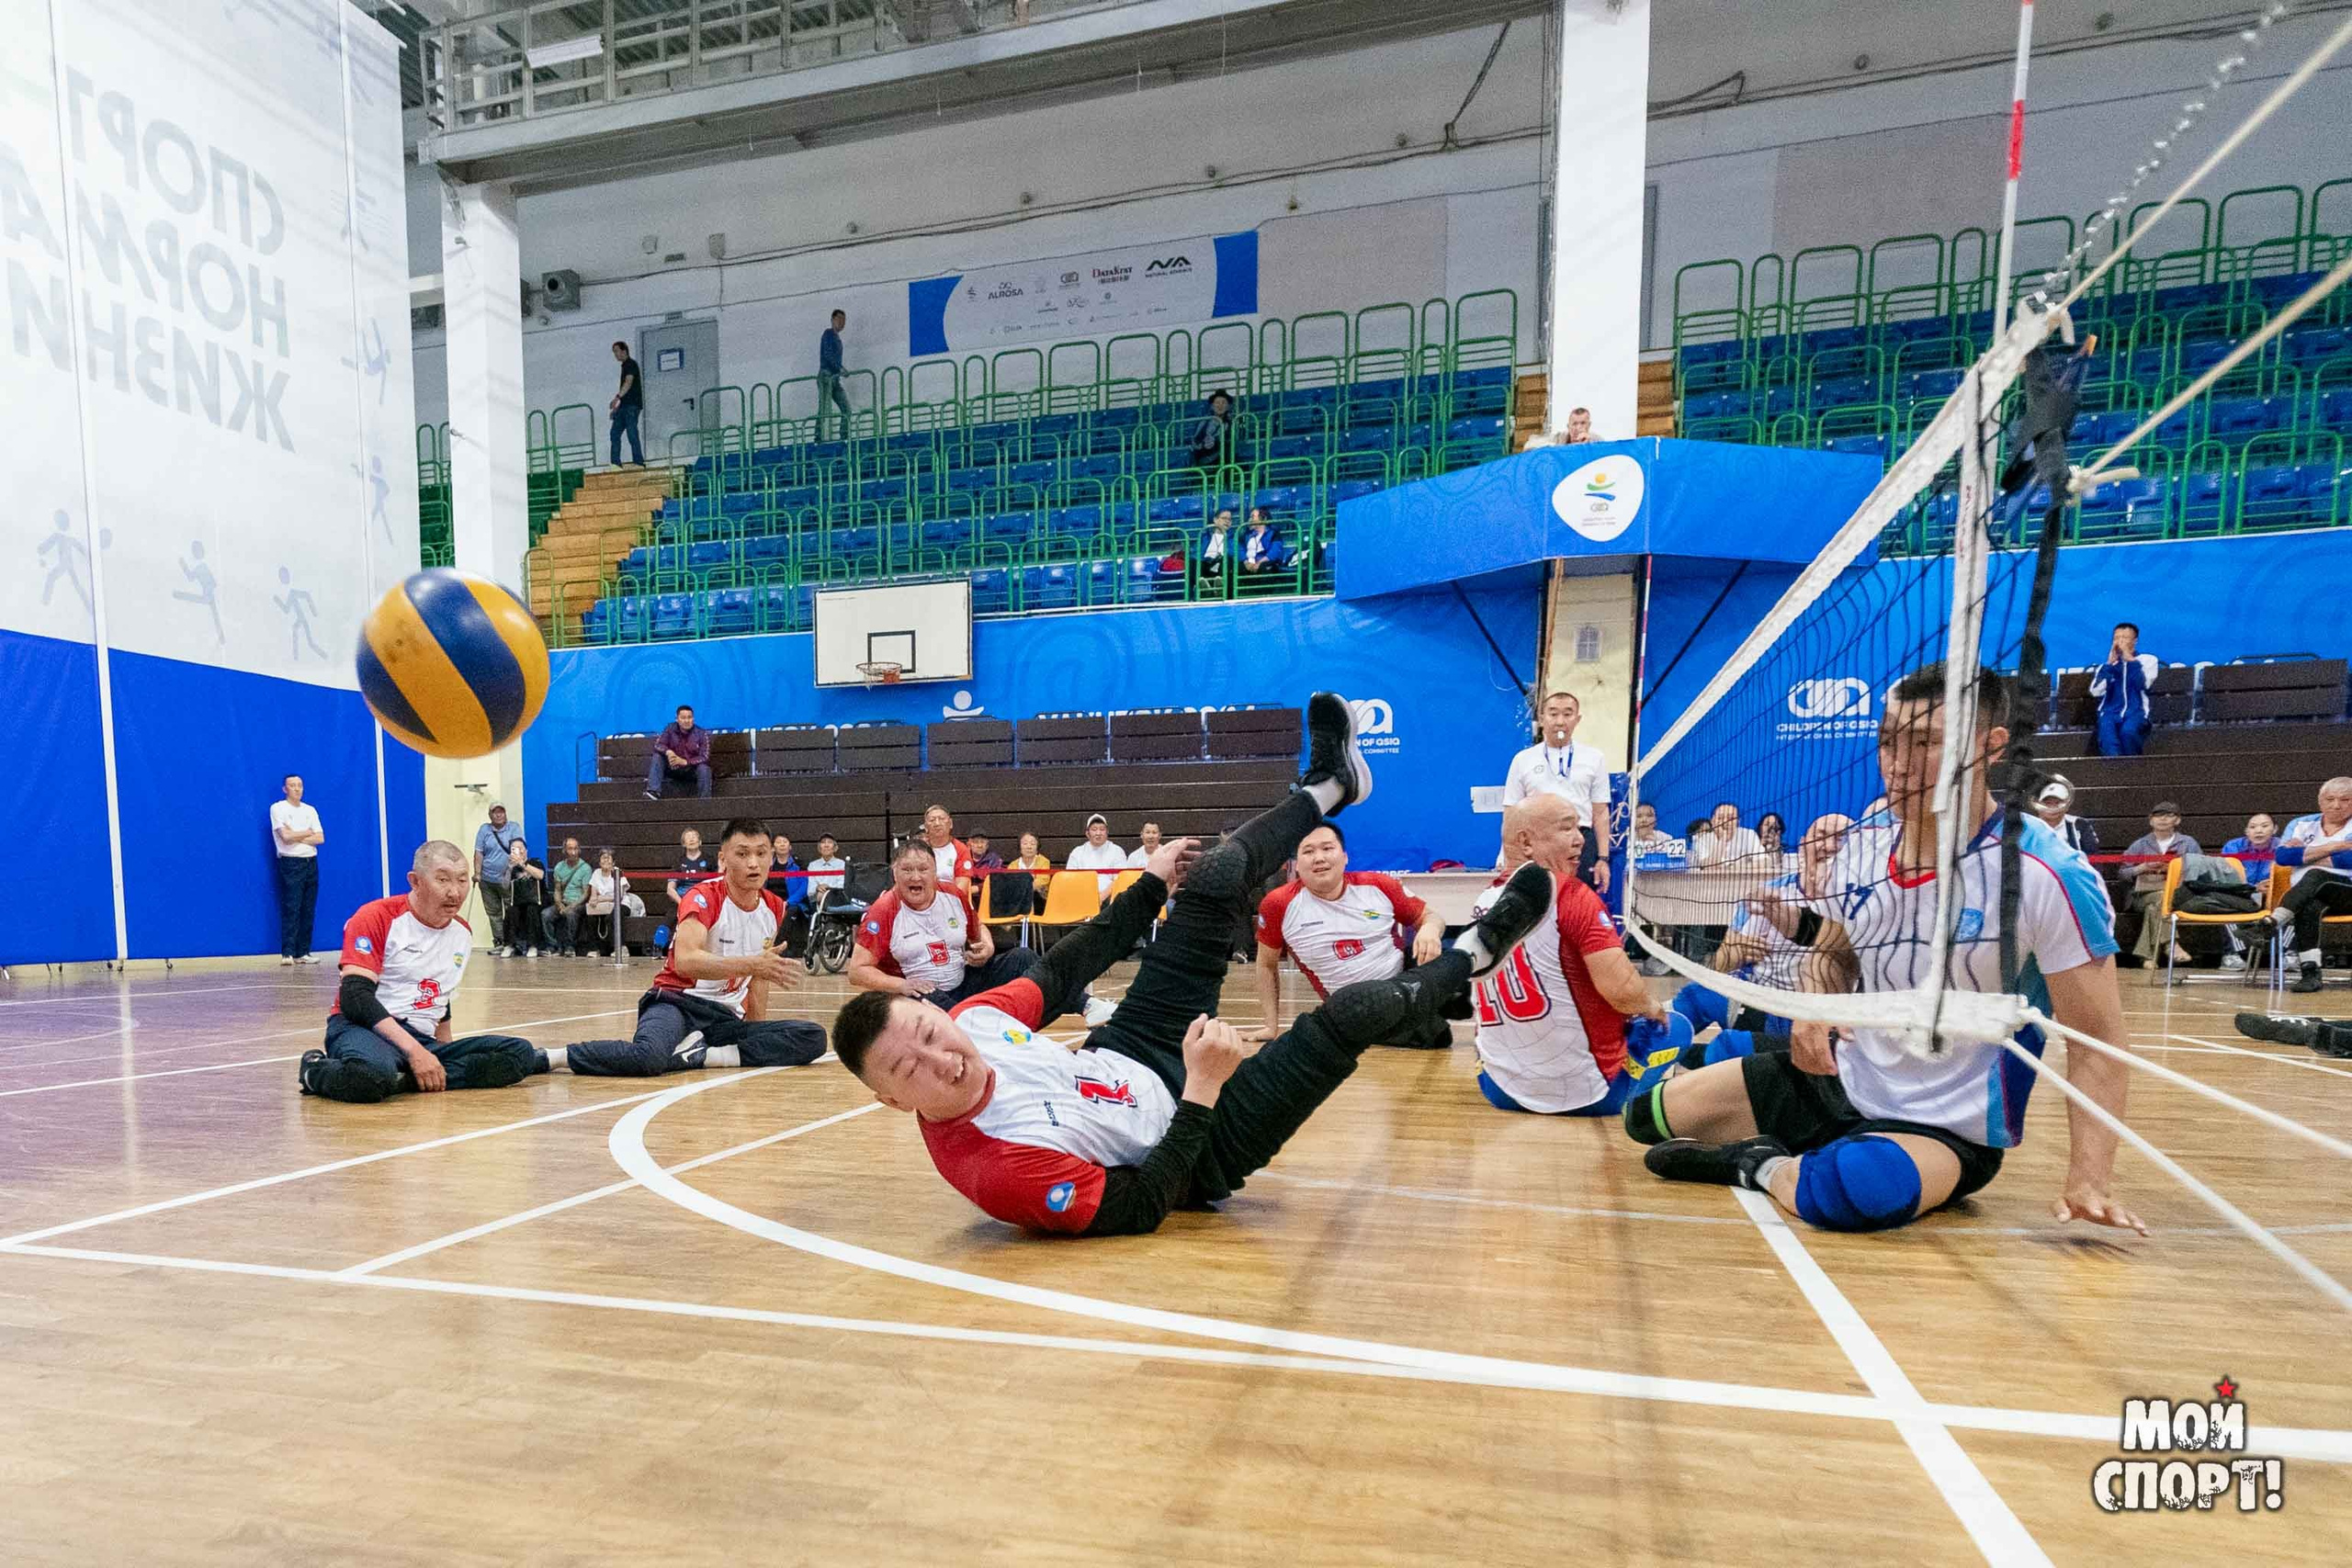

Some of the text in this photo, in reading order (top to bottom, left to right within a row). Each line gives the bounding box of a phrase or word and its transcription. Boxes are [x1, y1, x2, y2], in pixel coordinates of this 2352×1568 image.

[988, 288, 1023, 300] ALROSA
[1363, 738, 1374, 747] OF
[1668, 843, 1685, 855] 22
